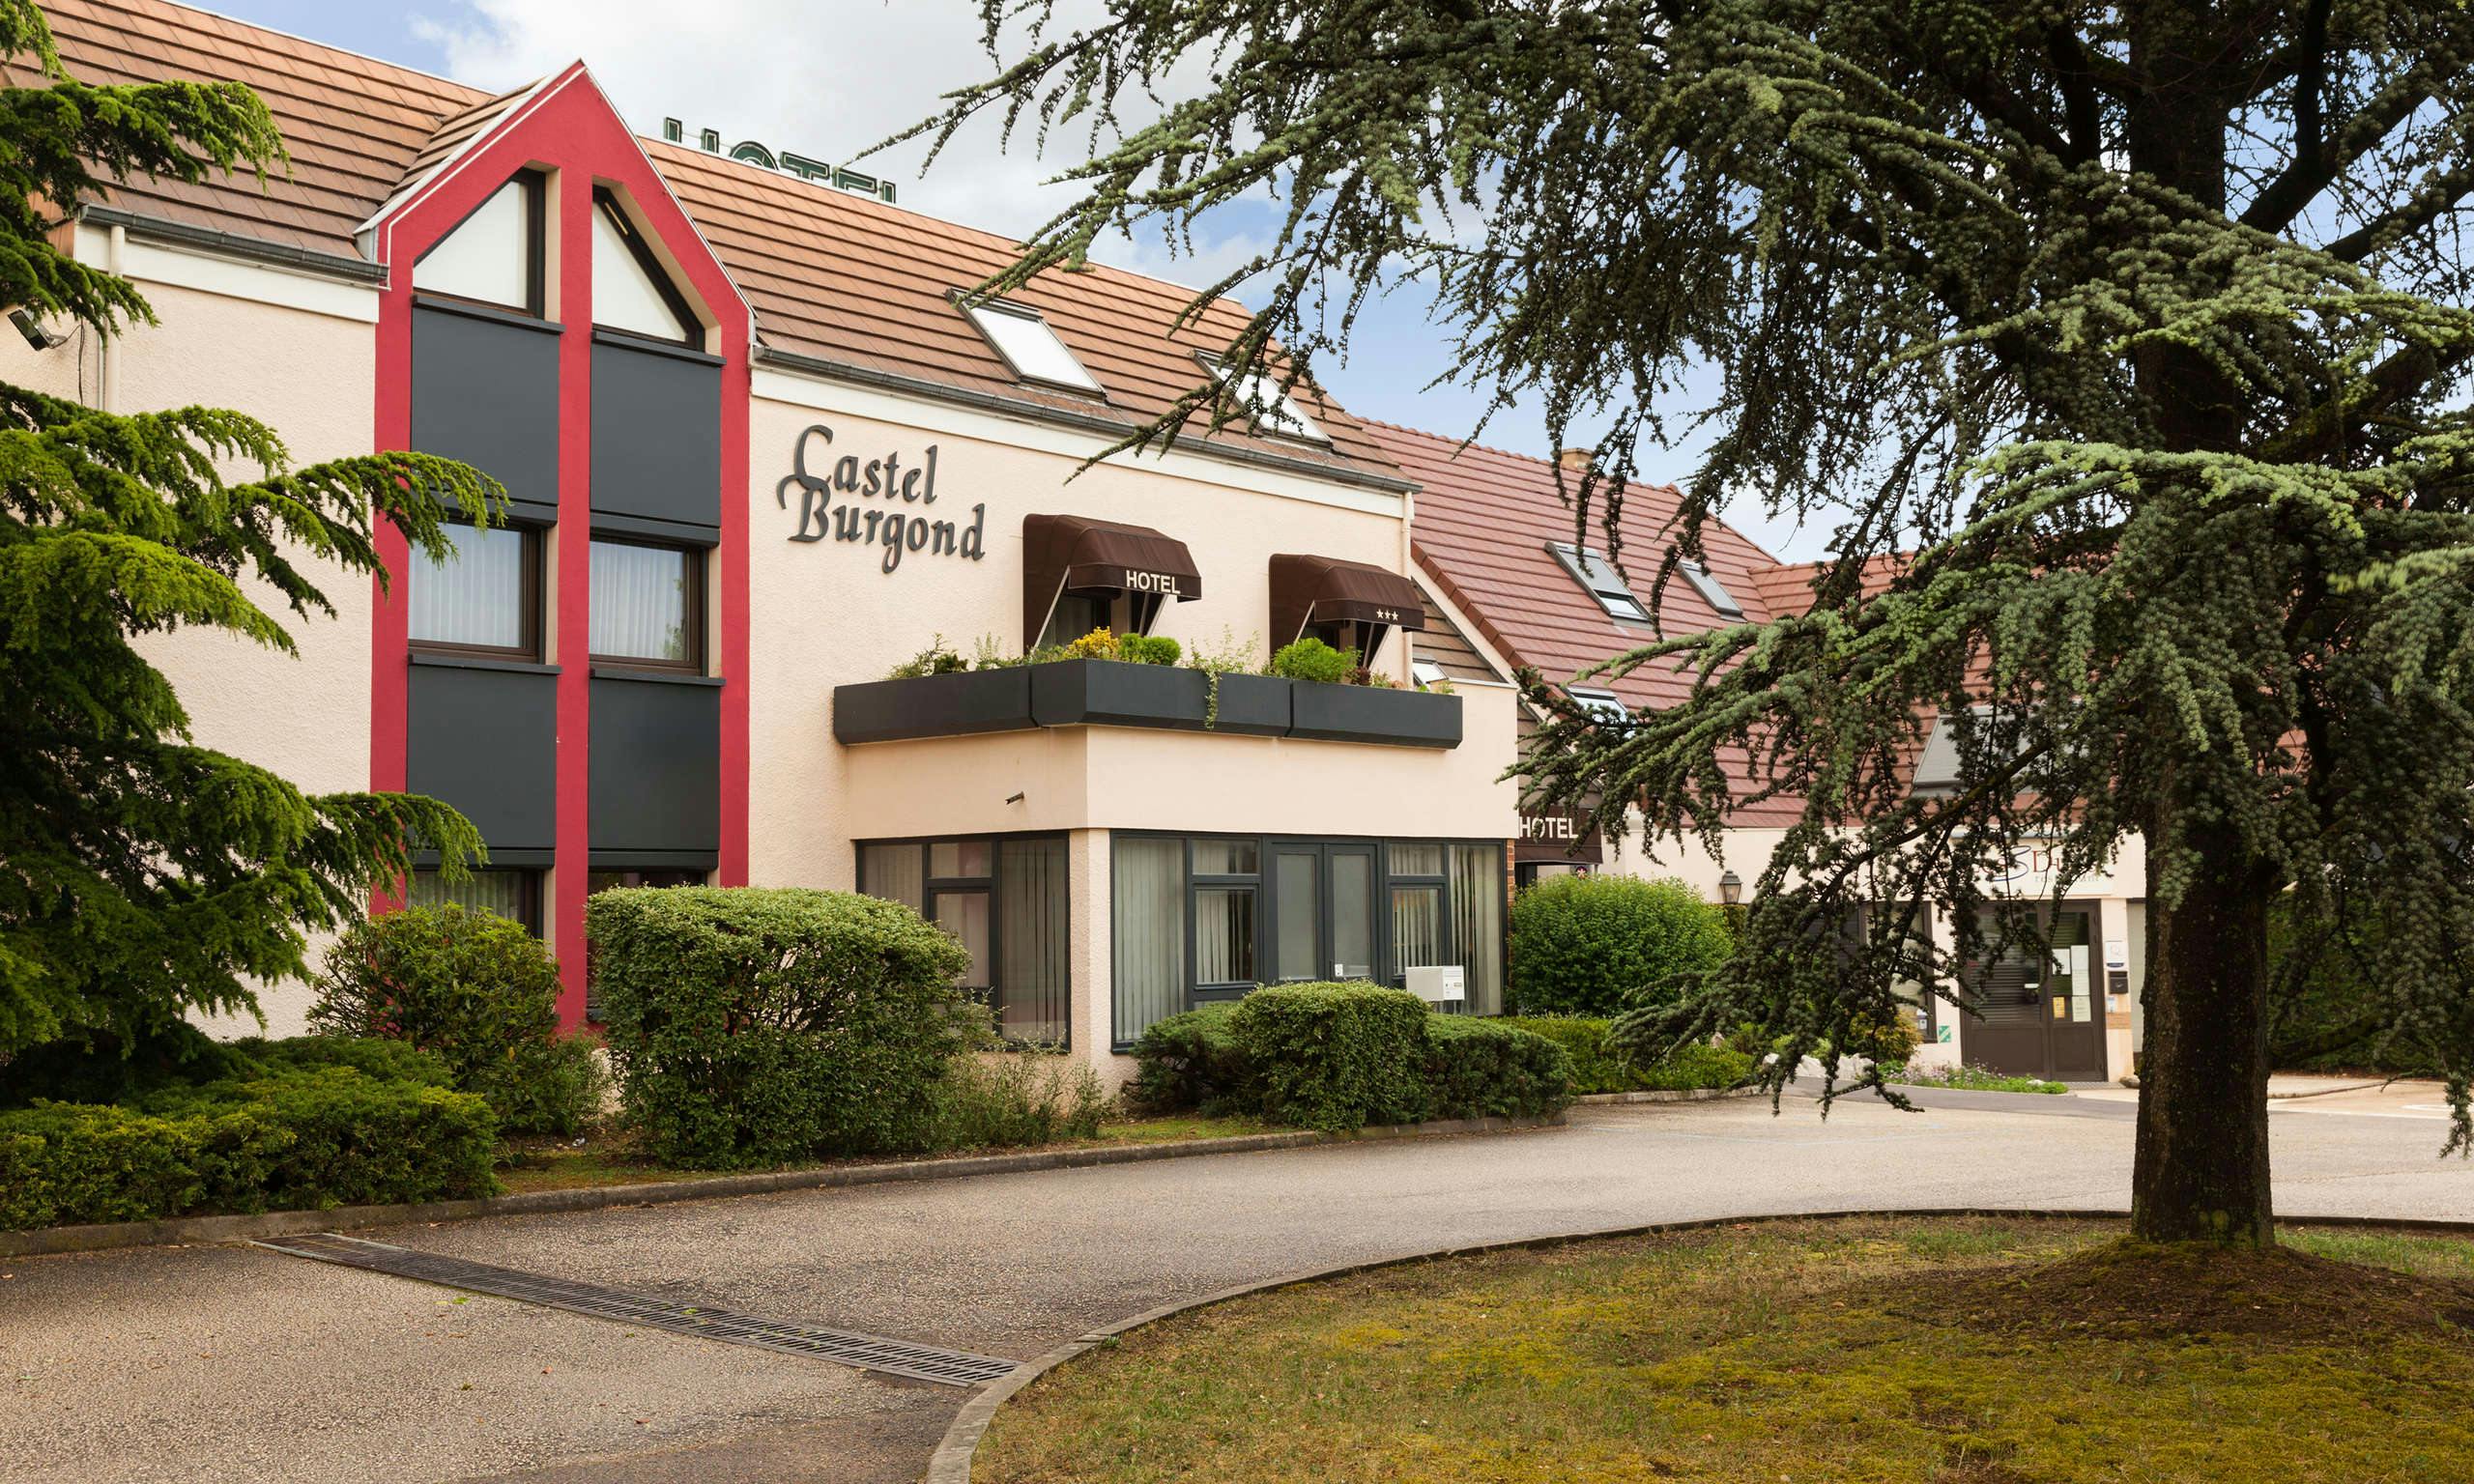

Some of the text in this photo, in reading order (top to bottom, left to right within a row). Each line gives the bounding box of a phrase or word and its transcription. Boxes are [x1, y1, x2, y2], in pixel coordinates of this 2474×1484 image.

[793, 425, 938, 504] Castel
[776, 474, 986, 574] Burgond
[1126, 569, 1181, 595] HOTEL
[1519, 816, 1579, 840] HOTEL
